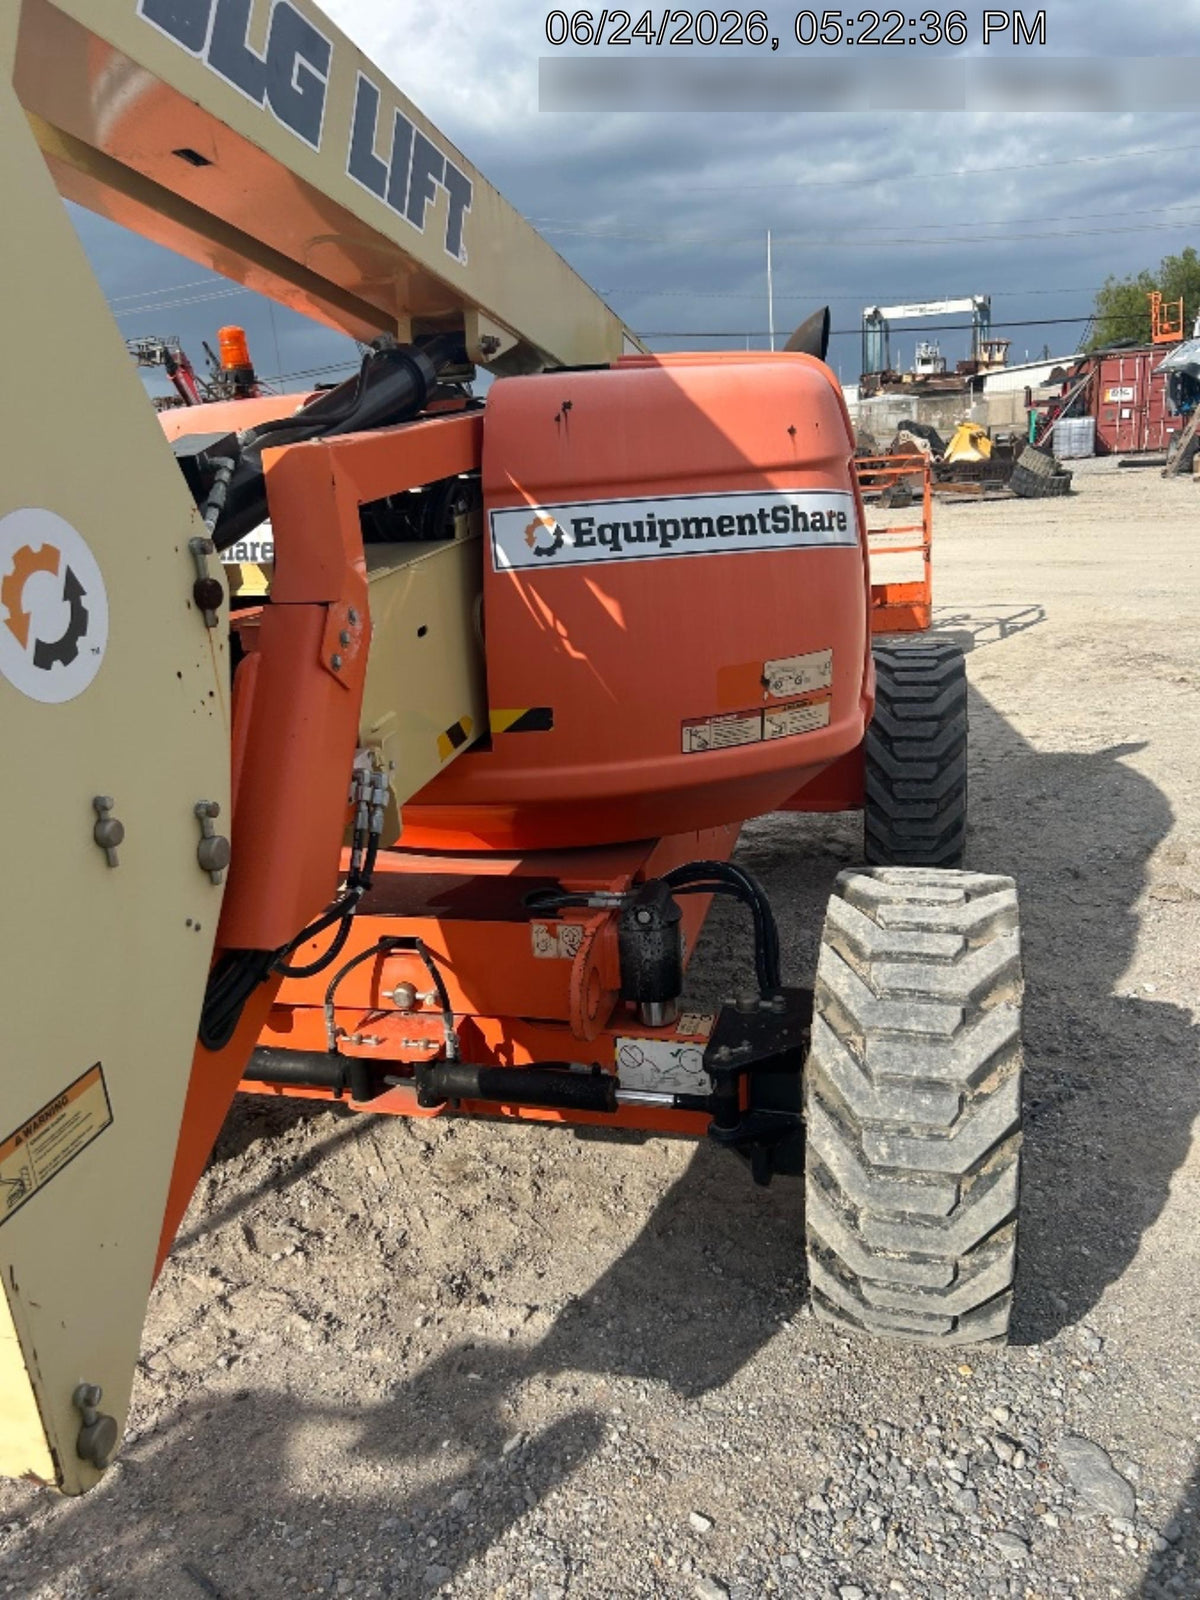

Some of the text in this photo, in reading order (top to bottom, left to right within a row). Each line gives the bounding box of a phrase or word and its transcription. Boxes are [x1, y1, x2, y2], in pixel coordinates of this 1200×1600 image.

[346, 70, 473, 264] LIFT
[570, 504, 847, 551] EquipmentShare
[22, 1095, 69, 1138] WARNING
